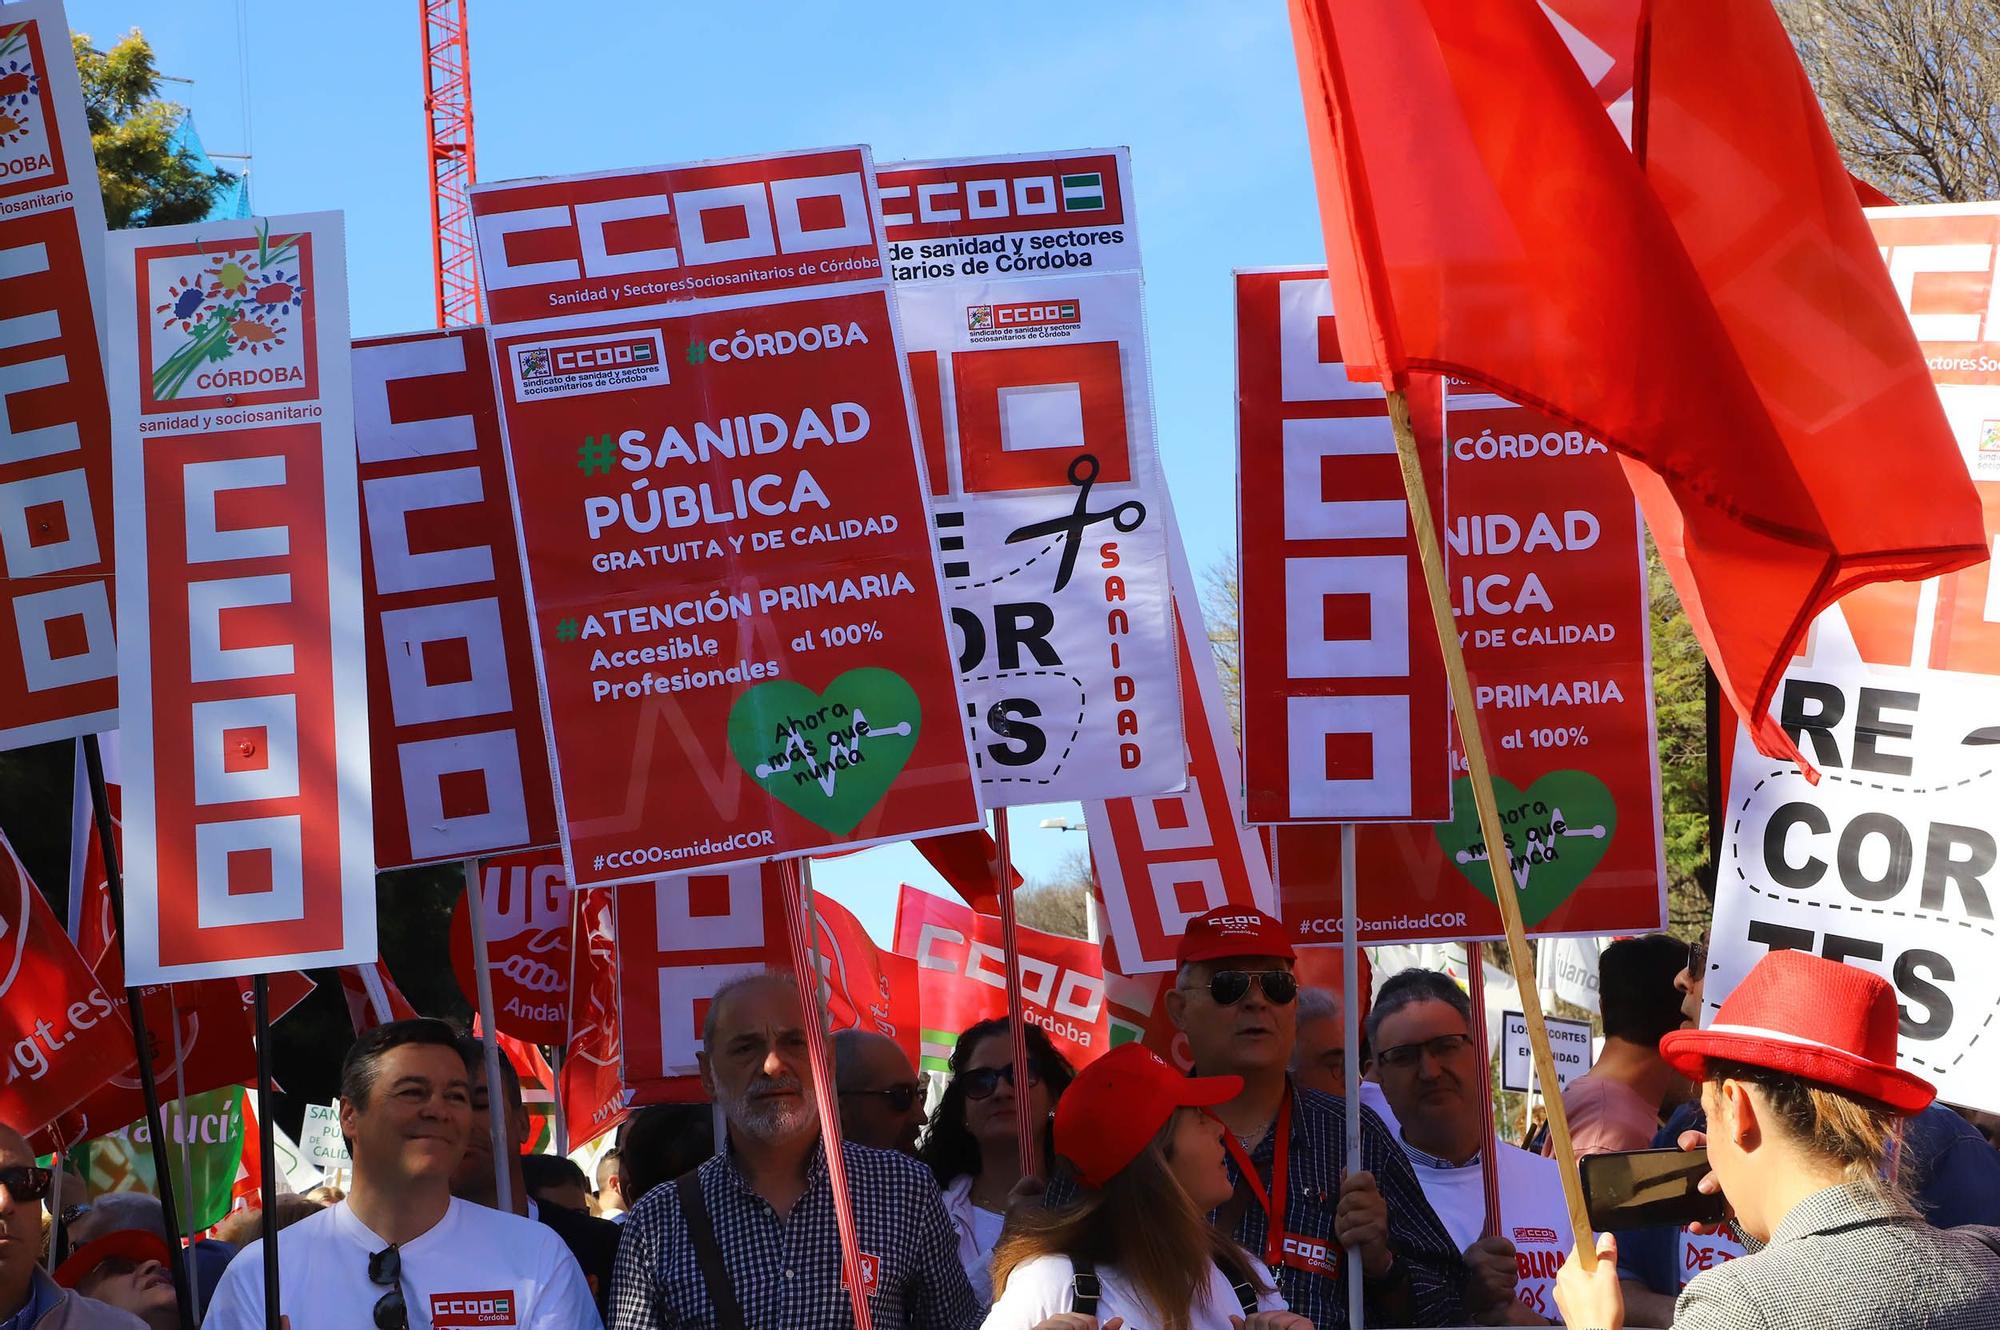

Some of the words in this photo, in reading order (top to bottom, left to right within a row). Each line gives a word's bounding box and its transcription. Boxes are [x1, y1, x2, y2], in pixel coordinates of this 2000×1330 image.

[476, 172, 872, 291] CCOO
[920, 235, 1006, 259] sanidad
[1012, 237, 1024, 256] y
[1030, 229, 1124, 248] sectores
[549, 285, 608, 306] Sanidad
[611, 287, 619, 300] y
[798, 260, 816, 276] de
[820, 256, 880, 274] Córdoba
[962, 258, 989, 276] de
[996, 252, 1092, 273] Córdoba
[999, 306, 1060, 323] CCOO
[686, 322, 869, 365] #CÓRDOBA
[970, 334, 1026, 343] sociosanitarios
[557, 345, 632, 369] CCOO
[197, 366, 303, 389] CÓRDOBA
[523, 377, 562, 388] sindicato
[578, 372, 613, 381] sanidad
[622, 366, 659, 376] sectores
[525, 382, 592, 395] sociosanitarios
[609, 374, 647, 385] Córdoba
[139, 414, 199, 433] sanidad
[203, 415, 212, 430] y
[216, 405, 322, 426] sociosanitario
[577, 402, 871, 477] #SANIDAD
[1448, 429, 1609, 461] CÓRDOBA
[584, 469, 831, 540] PÚBLICA
[592, 539, 724, 573] GRATUITA
[728, 535, 745, 554] Y
[752, 529, 785, 552] DE
[790, 514, 899, 546] CALIDAD
[352, 336, 530, 861] CCOO
[555, 589, 751, 643] #ATENCIÓN
[759, 572, 915, 613] PRIMARIA
[589, 635, 719, 672] Accesible
[791, 627, 815, 653] al
[820, 620, 884, 647] 100%
[1474, 628, 1506, 648] DE
[1512, 624, 1615, 645] CALIDAD
[1100, 541, 1142, 770] SANIDAD
[183, 455, 304, 929] CCOO
[592, 659, 780, 702] Profesionales
[1476, 679, 1624, 710] PRIMARIA
[775, 701, 849, 744] Ahora
[1501, 730, 1524, 750] al
[1529, 726, 1589, 749] 100%
[1775, 679, 1921, 777] RE
[768, 739, 817, 772] más
[826, 720, 870, 748] que
[794, 749, 865, 786] nunca
[1526, 820, 1567, 843] que
[592, 829, 775, 872] #CCOOsanidadCOR
[1762, 801, 1998, 920] COR
[1208, 916, 1261, 926] CCOO
[917, 923, 1102, 1023] CCOO
[503, 996, 566, 1022] Andal
[1686, 1242, 1714, 1270] DE
[434, 1300, 494, 1315] CCOO
